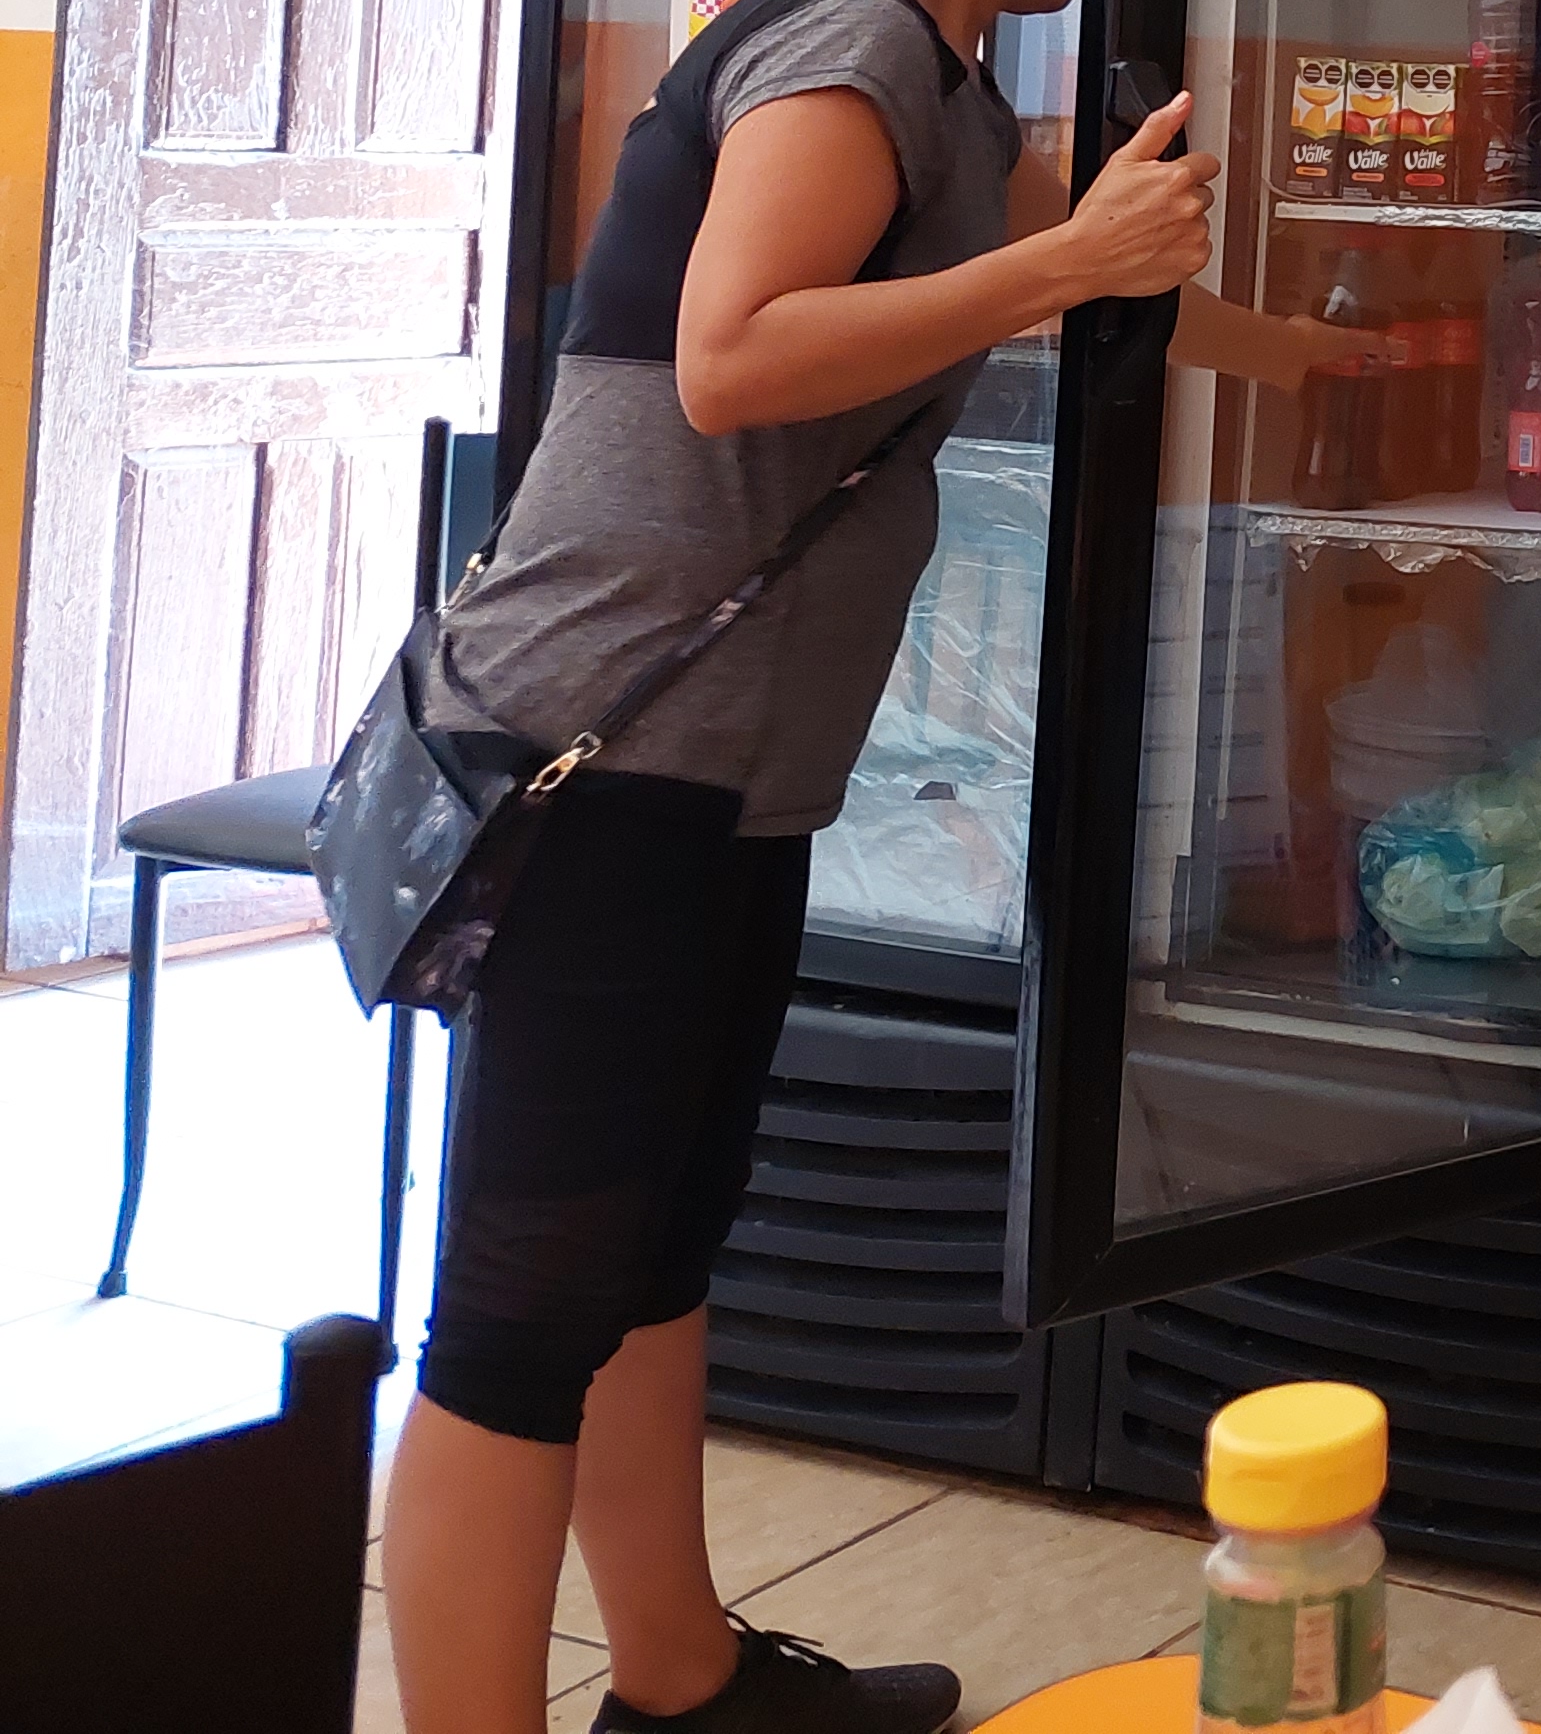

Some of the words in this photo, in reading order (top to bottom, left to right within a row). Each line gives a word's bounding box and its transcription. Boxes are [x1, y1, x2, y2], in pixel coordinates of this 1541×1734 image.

[1293, 144, 1334, 164] Valle
[1349, 149, 1390, 170] Valle
[1405, 150, 1447, 171] Valle
